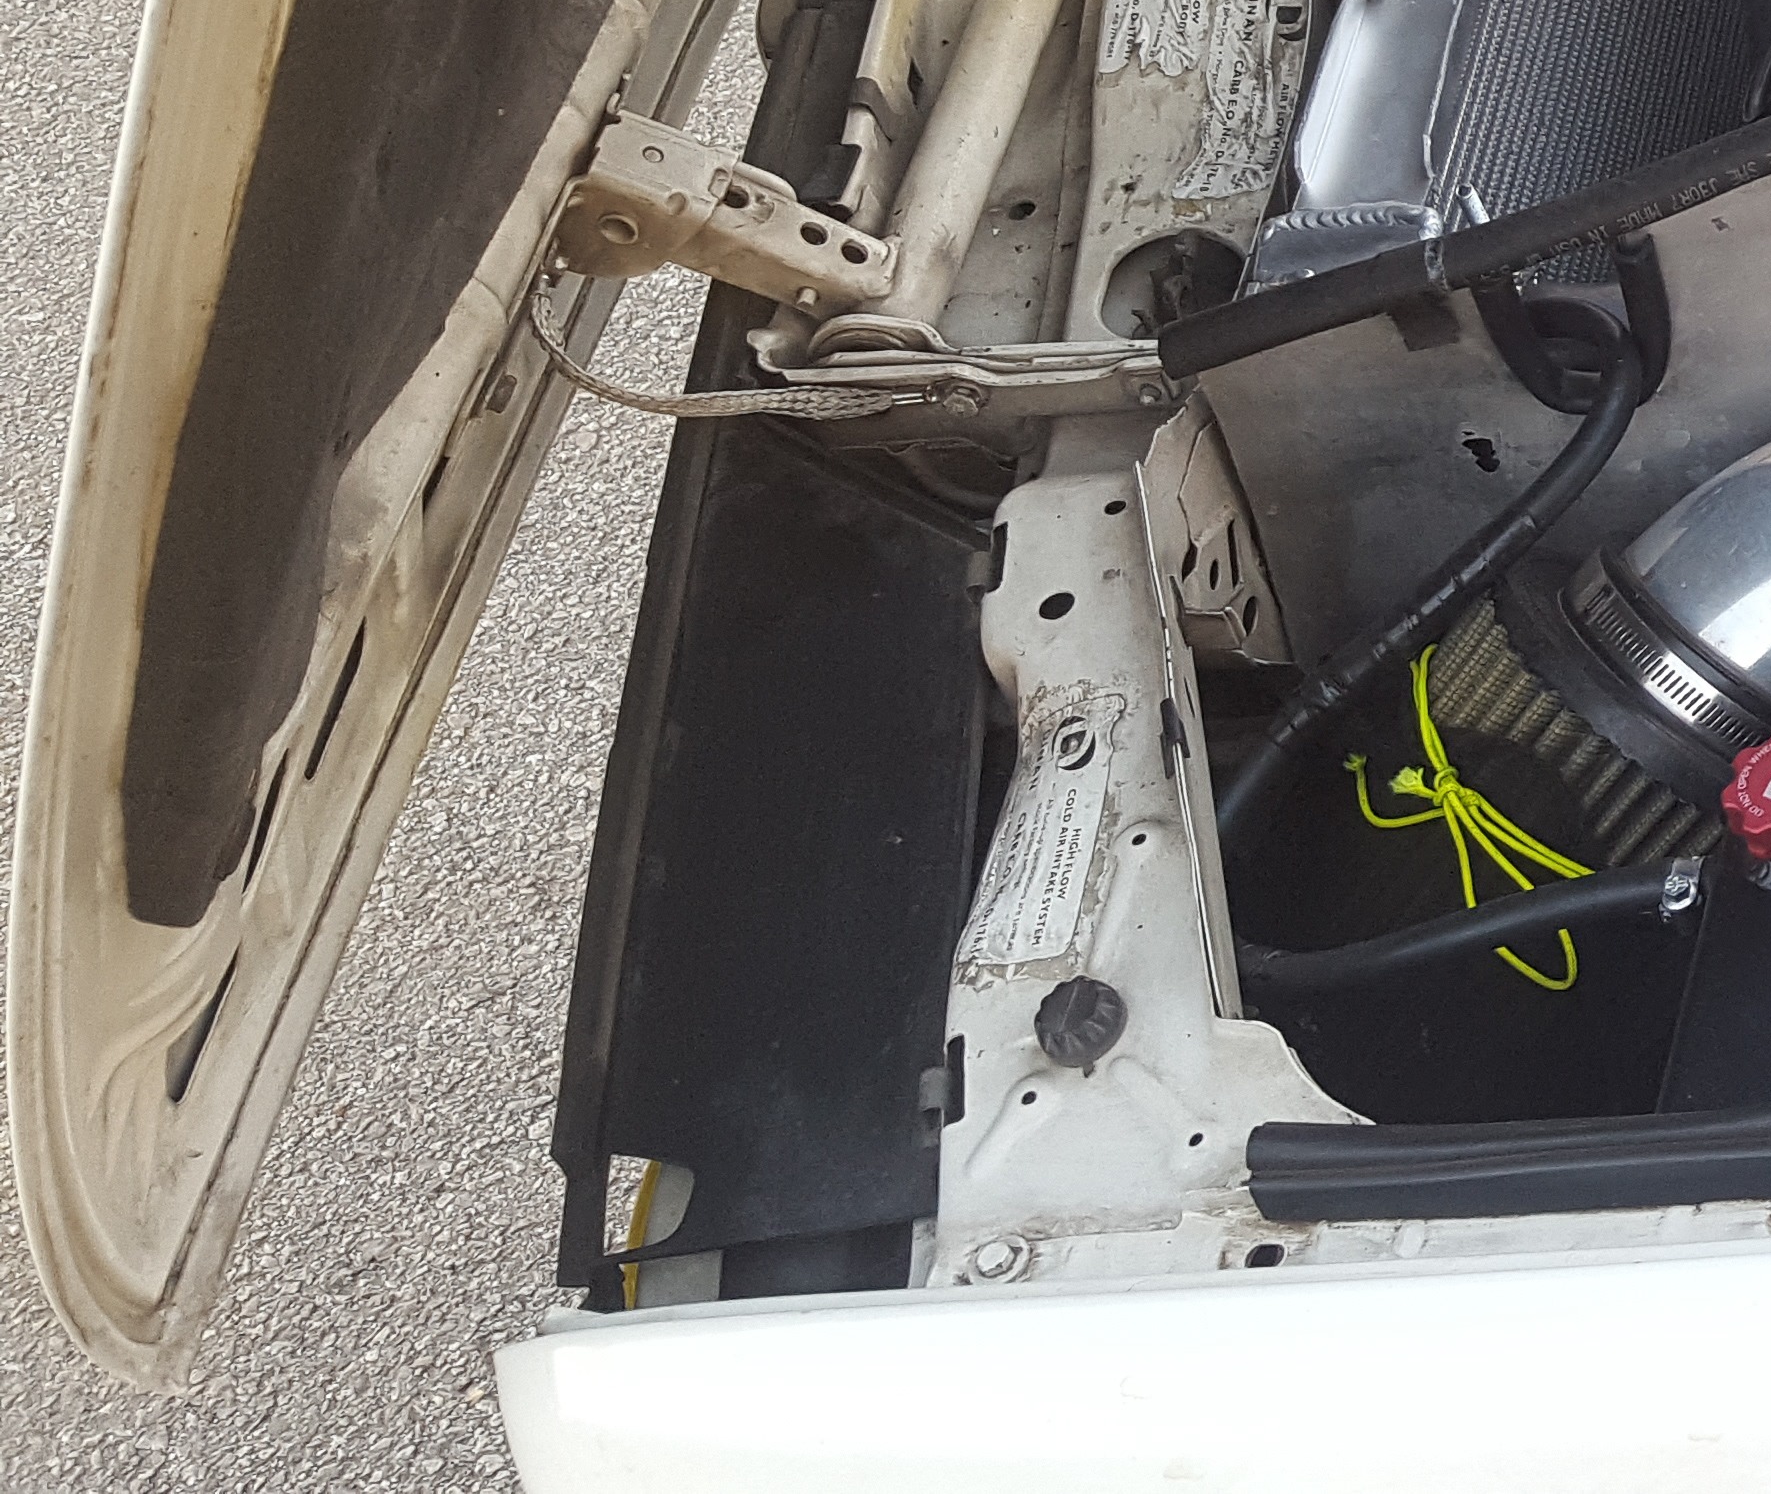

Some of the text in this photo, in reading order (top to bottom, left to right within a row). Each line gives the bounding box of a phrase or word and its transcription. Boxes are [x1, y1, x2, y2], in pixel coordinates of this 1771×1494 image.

[1228, 59, 1244, 95] CARB
[1278, 83, 1290, 102] AIR
[1272, 104, 1286, 138] FLOW
[1748, 806, 1764, 817] DO
[1030, 787, 1077, 947] COLD AIR INTAKE SYSTEM
[1056, 826, 1082, 900] HIGH FLOW
